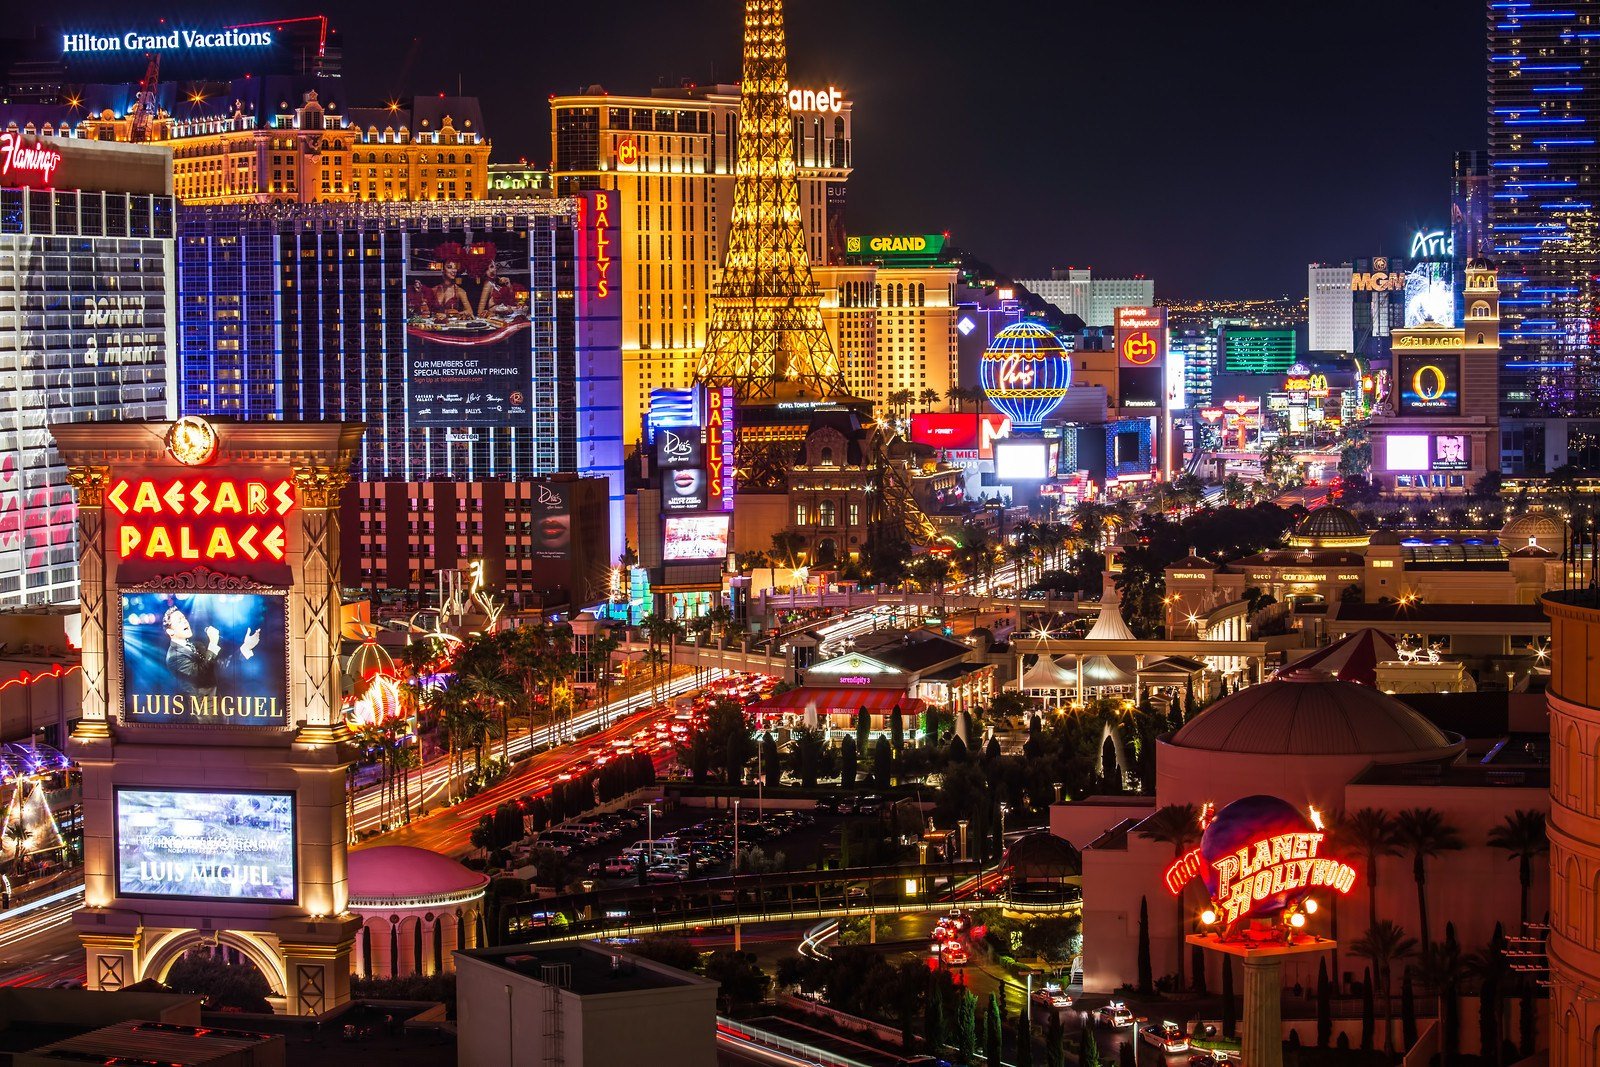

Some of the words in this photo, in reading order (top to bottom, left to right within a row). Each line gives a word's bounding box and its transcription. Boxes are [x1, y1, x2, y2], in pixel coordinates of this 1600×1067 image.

[63, 34, 120, 52] Hilton
[124, 31, 179, 50] Grand
[182, 28, 271, 48] Vacations
[789, 86, 842, 113] anet
[0, 133, 61, 183] Flamingo
[870, 237, 926, 252] GRAND
[1120, 308, 1147, 318] planet
[1120, 319, 1160, 328] hollywood
[1400, 336, 1462, 347] BELLAGIO
[413, 360, 430, 368] OUR
[430, 360, 464, 368] MEMBERS
[464, 360, 479, 368] GET
[413, 369, 441, 377] SPECIAL
[442, 368, 488, 376] RESTAURANT
[489, 367, 519, 375] PRICING
[1412, 365, 1446, 400] O
[108, 479, 295, 515] CAESARS
[120, 525, 285, 560] PALACE
[840, 676, 867, 685] serendipity
[132, 694, 186, 715] LUIS
[190, 695, 283, 718] MIGUEL
[140, 861, 185, 883] LUIS
[189, 863, 273, 886] MIGUEL
[1212, 832, 1323, 899] PLANET
[417, 897, 446, 905] CAESARS
[1222, 858, 1356, 924] HOLLYWOOD
